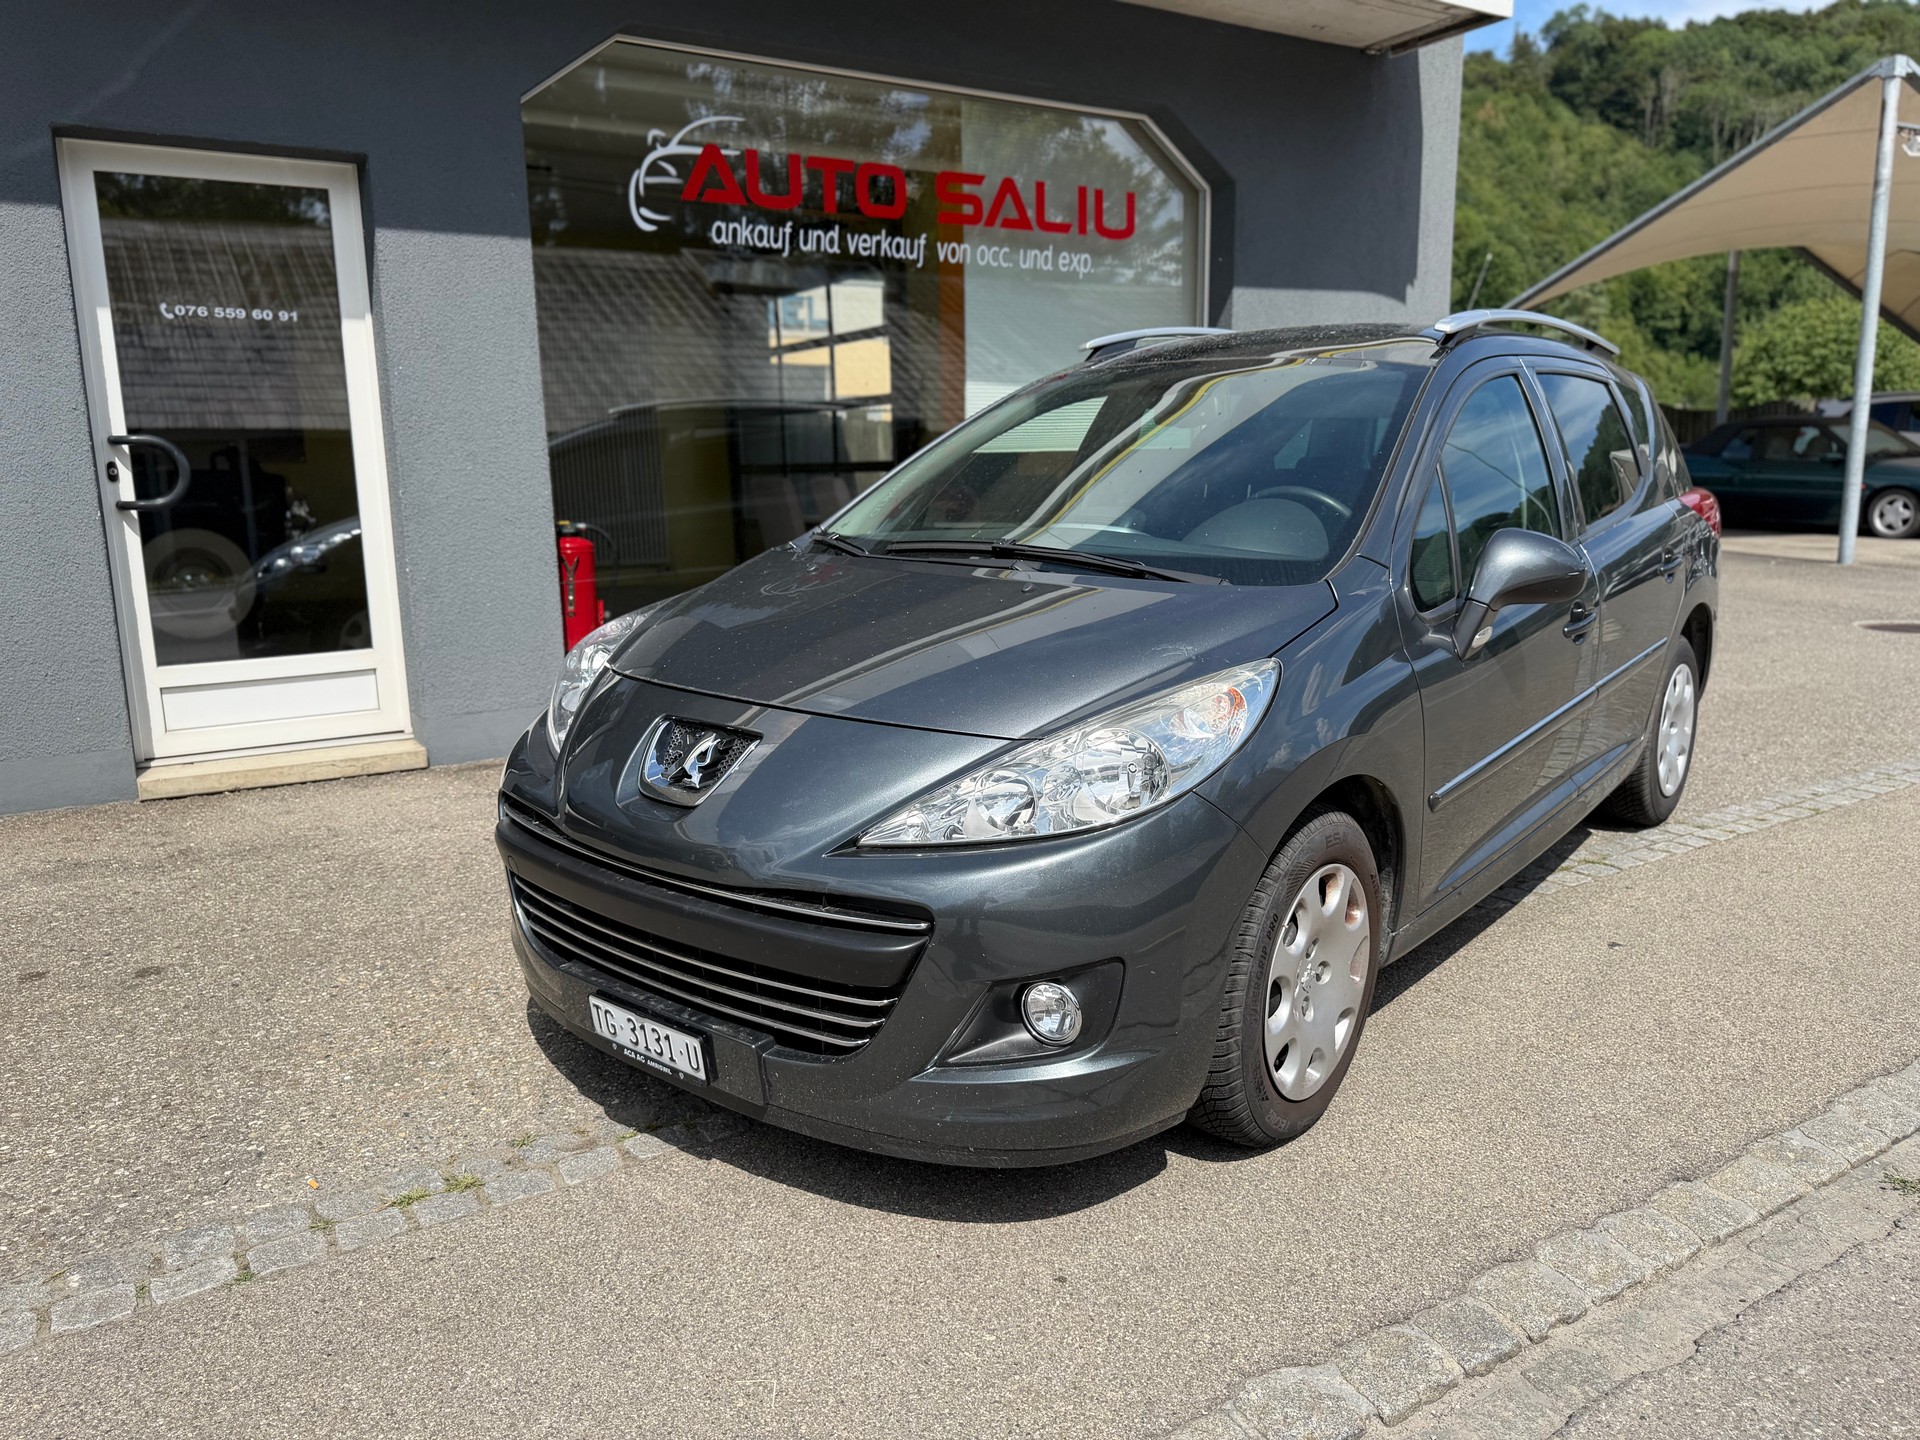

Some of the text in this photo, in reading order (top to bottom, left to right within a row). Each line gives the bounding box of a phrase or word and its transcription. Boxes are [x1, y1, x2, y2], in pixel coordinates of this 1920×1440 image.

[681, 143, 1136, 239] AUTO SALIU
[711, 216, 1095, 279] ankauf und verkauf von occ. und exp.
[174, 304, 298, 322] 076 559 60 91
[1266, 913, 1279, 940] PRO
